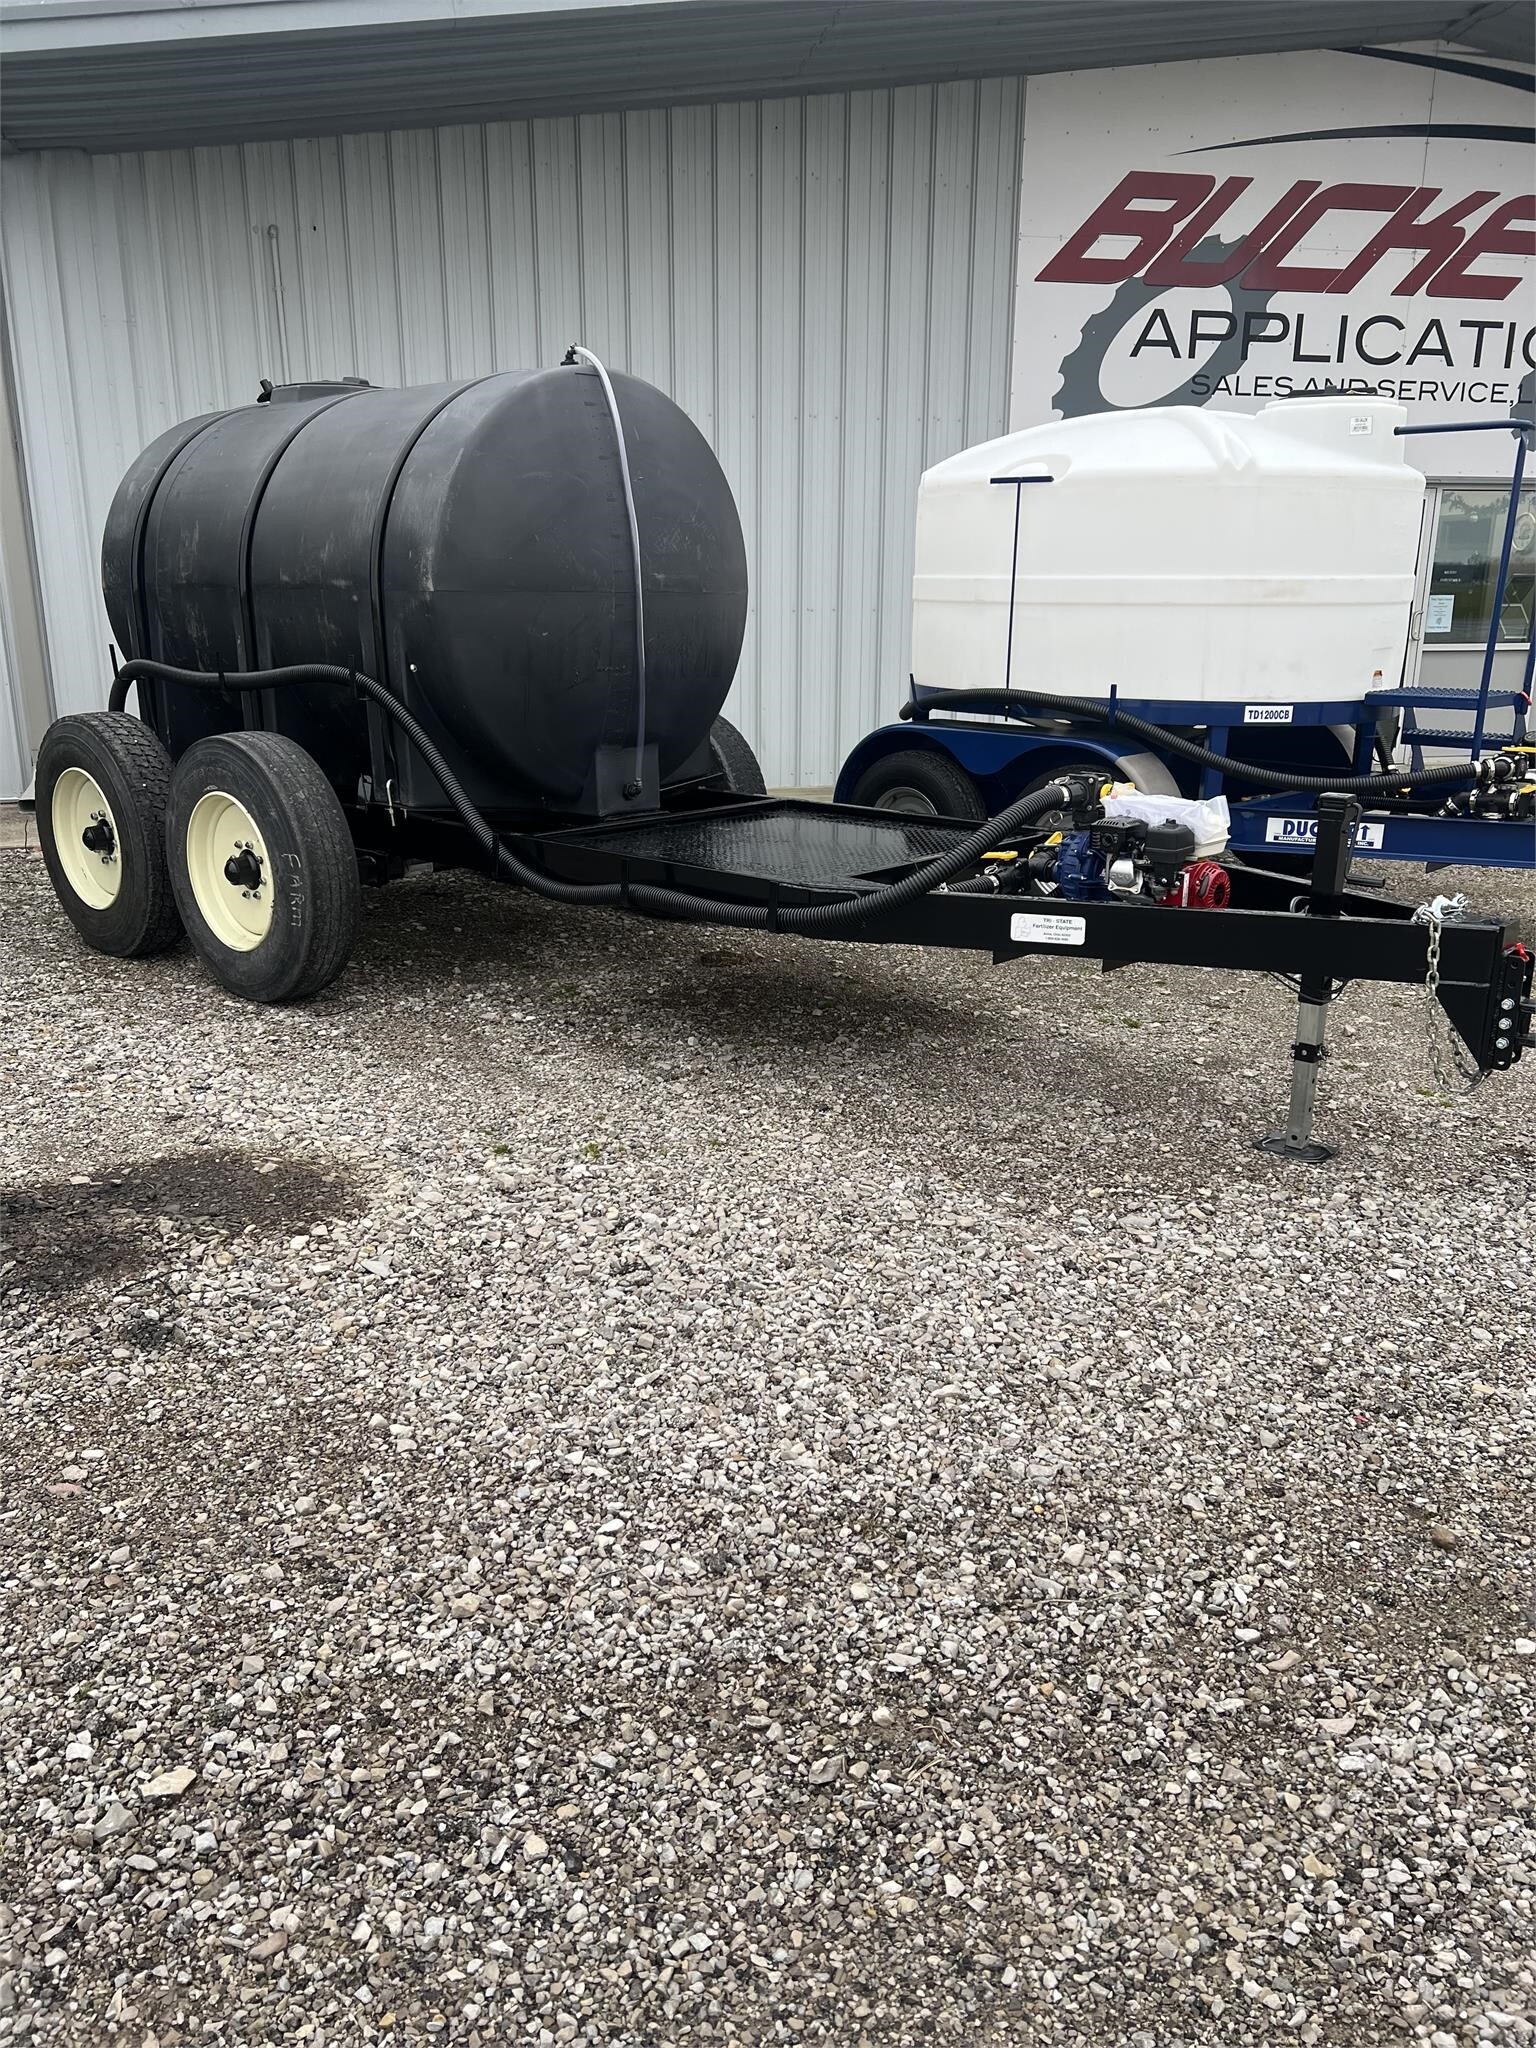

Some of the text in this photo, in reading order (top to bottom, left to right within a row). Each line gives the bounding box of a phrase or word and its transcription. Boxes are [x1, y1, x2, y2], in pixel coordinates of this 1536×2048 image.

[1034, 170, 1536, 300] BUCKE
[1129, 308, 1536, 370] APPLICATI
[1190, 374, 1294, 397] SALES
[1248, 709, 1290, 720] TD1200CB
[281, 853, 305, 927] FARM
